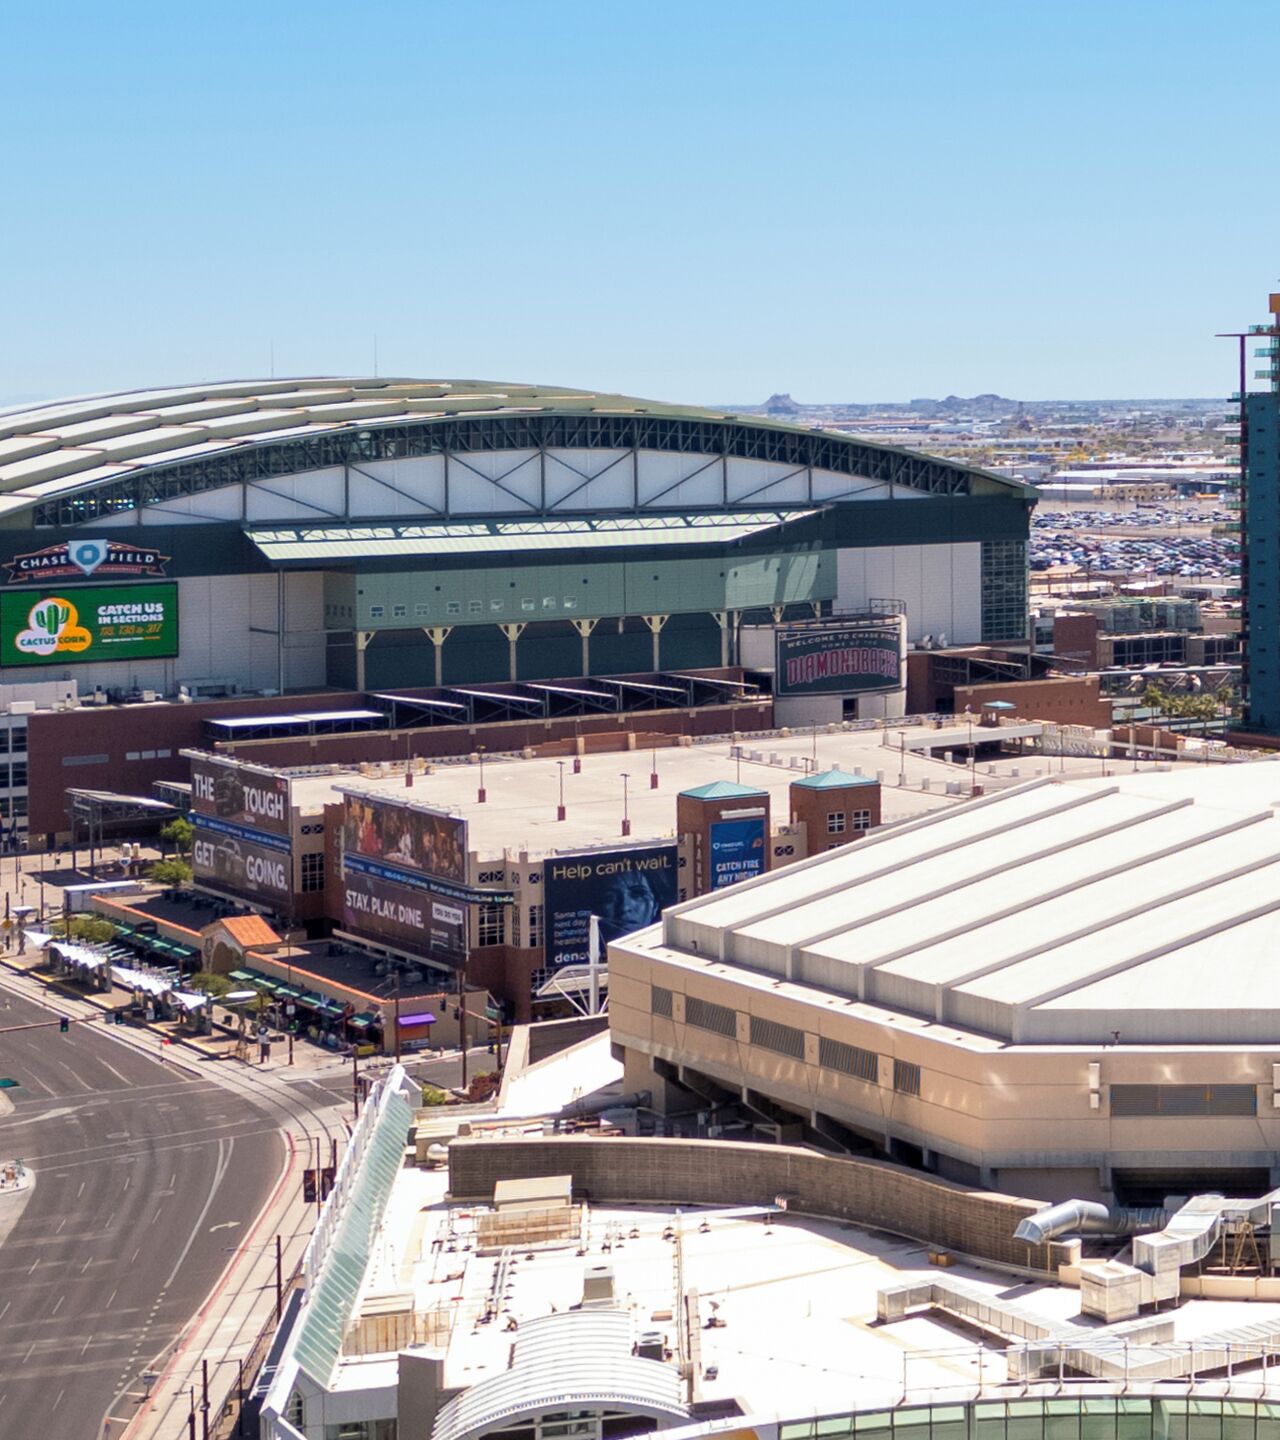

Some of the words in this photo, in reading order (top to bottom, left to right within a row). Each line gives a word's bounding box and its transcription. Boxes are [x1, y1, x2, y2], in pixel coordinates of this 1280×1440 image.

[20, 556, 67, 569] CHASE
[110, 553, 155, 563] FIELD
[97, 604, 142, 615] CATCH
[144, 603, 164, 613] US
[98, 616, 111, 624] IN
[112, 613, 164, 623] SECTIONS
[20, 637, 56, 646] CACTUS
[58, 635, 86, 643] CORN
[787, 635, 835, 648] WELCOME
[786, 648, 898, 686] DIAMONDBACKS
[194, 773, 215, 801] THE
[243, 786, 284, 820] TOUGH
[194, 840, 215, 867] GET
[246, 855, 288, 891] GOING.
[553, 864, 592, 880] Help
[596, 859, 632, 875] can't
[716, 861, 742, 872] CATCH
[345, 889, 370, 912] STAY.
[371, 896, 397, 920] PLAY.
[398, 904, 425, 929] DINE.
